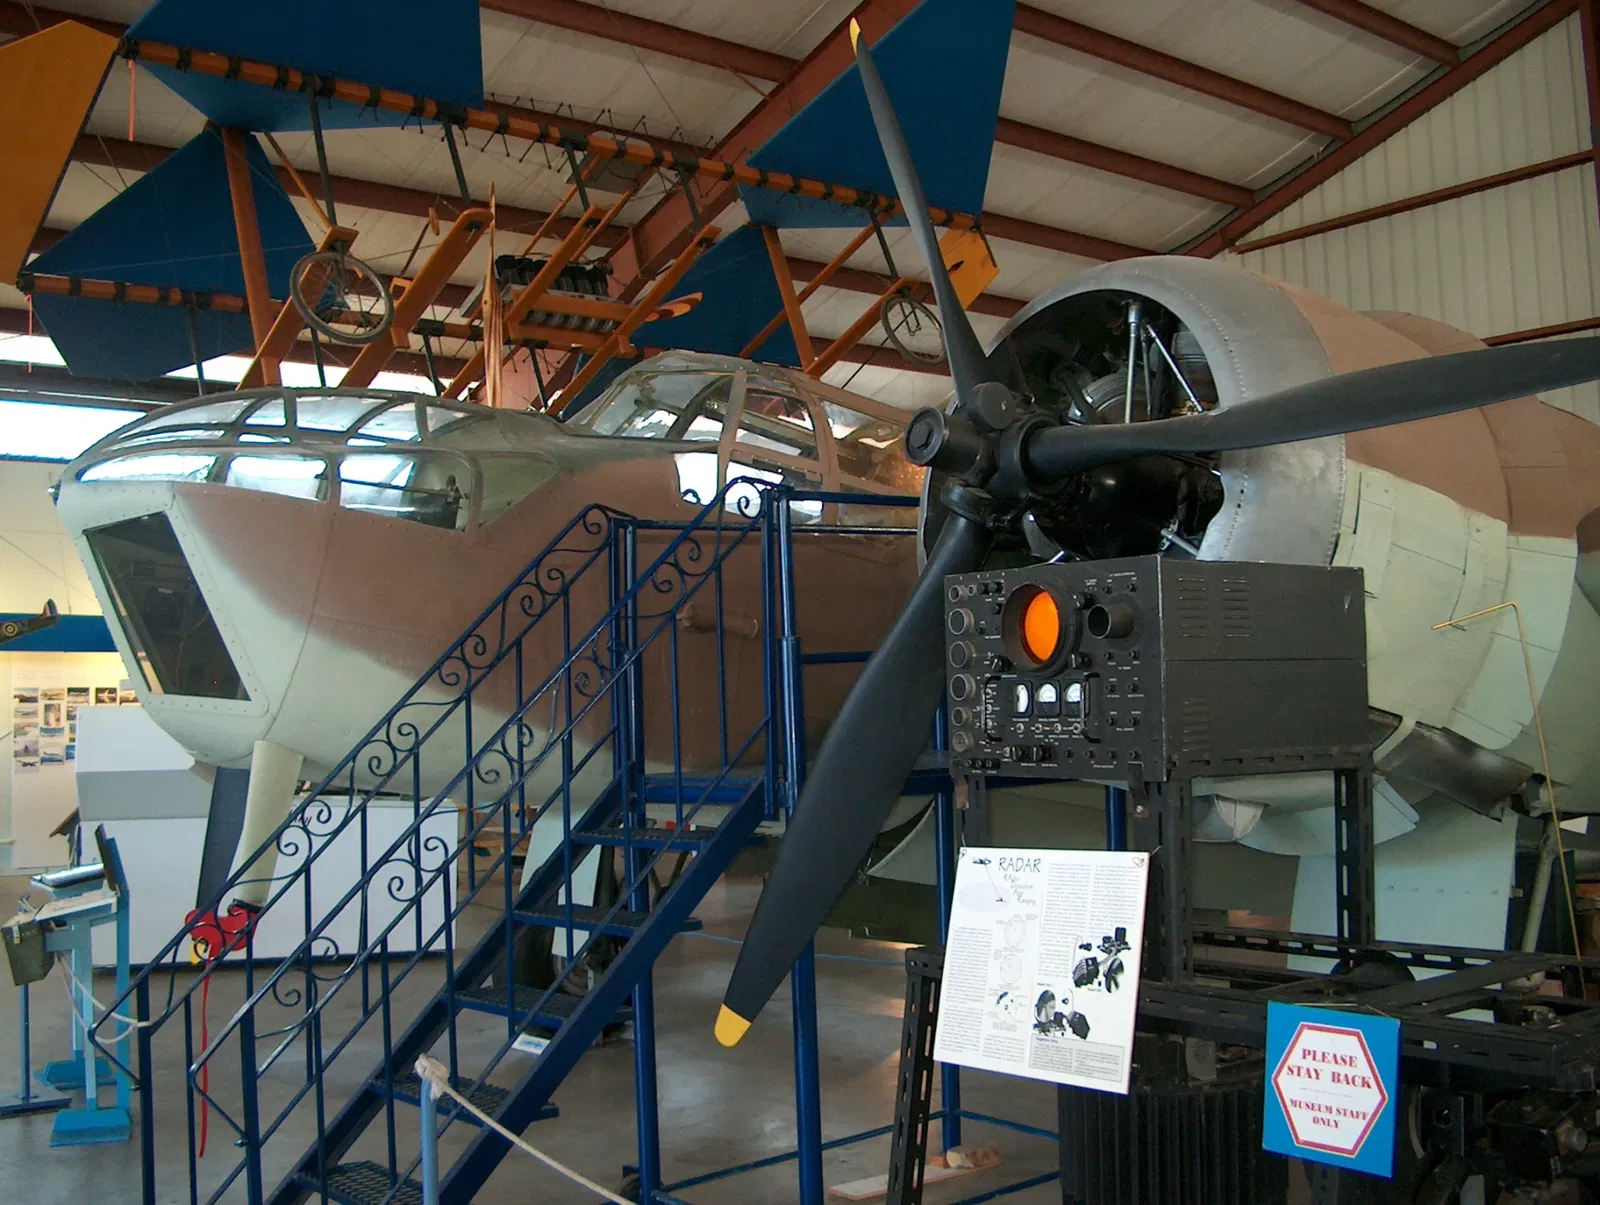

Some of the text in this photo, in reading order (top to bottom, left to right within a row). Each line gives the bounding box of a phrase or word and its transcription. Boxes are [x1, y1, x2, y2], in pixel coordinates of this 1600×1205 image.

[998, 857, 1042, 873] RADAR
[1302, 1048, 1358, 1068] PLEASE
[1287, 1064, 1372, 1089] STAY BACK
[1290, 1098, 1370, 1121] MUSEUM STAFF
[1312, 1116, 1340, 1129] ONLY
